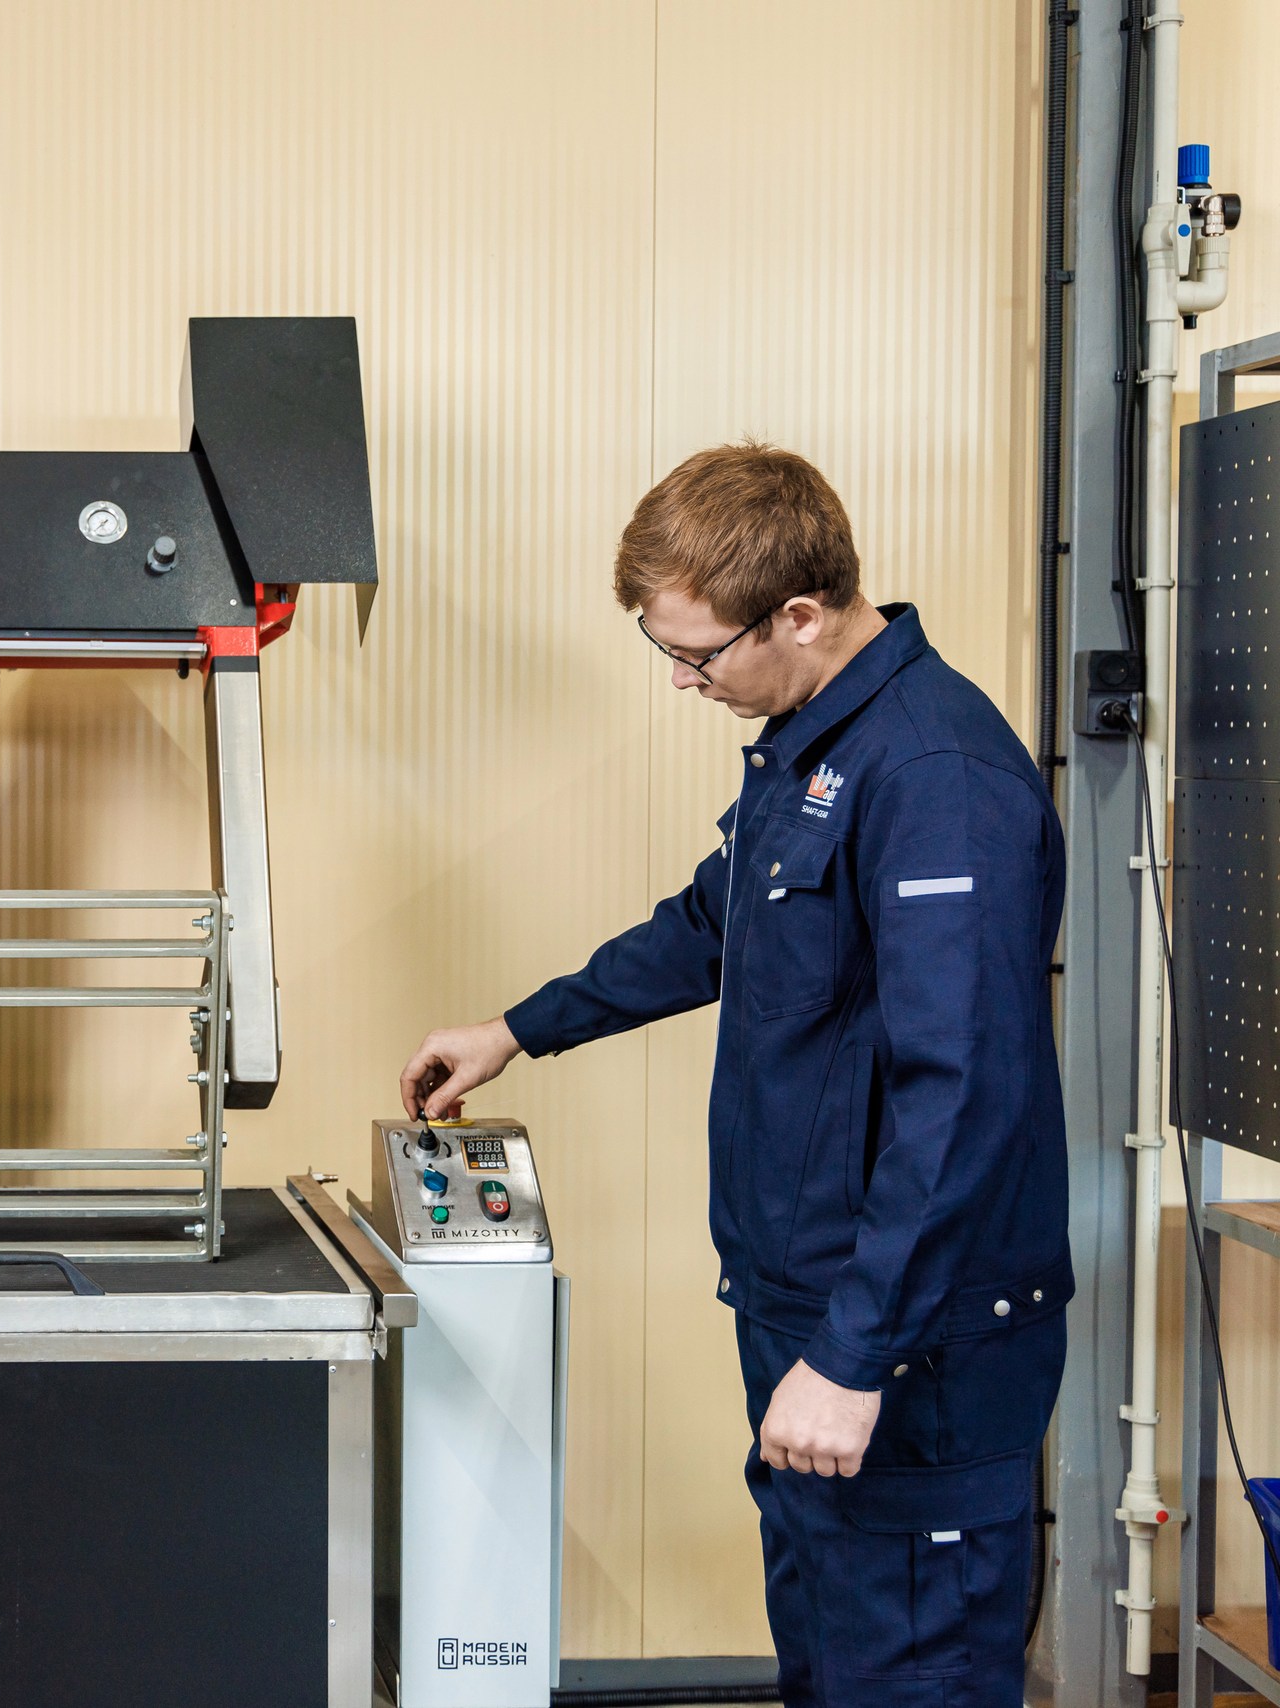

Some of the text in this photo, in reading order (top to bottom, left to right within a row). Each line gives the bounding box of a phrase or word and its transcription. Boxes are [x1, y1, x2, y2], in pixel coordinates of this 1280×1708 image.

[801, 804, 829, 819] SHAFT-GEAR
[451, 1229, 520, 1238] MIZOTTY
[462, 1642, 527, 1653] MADE IN
[462, 1654, 527, 1666] RUSSIA
